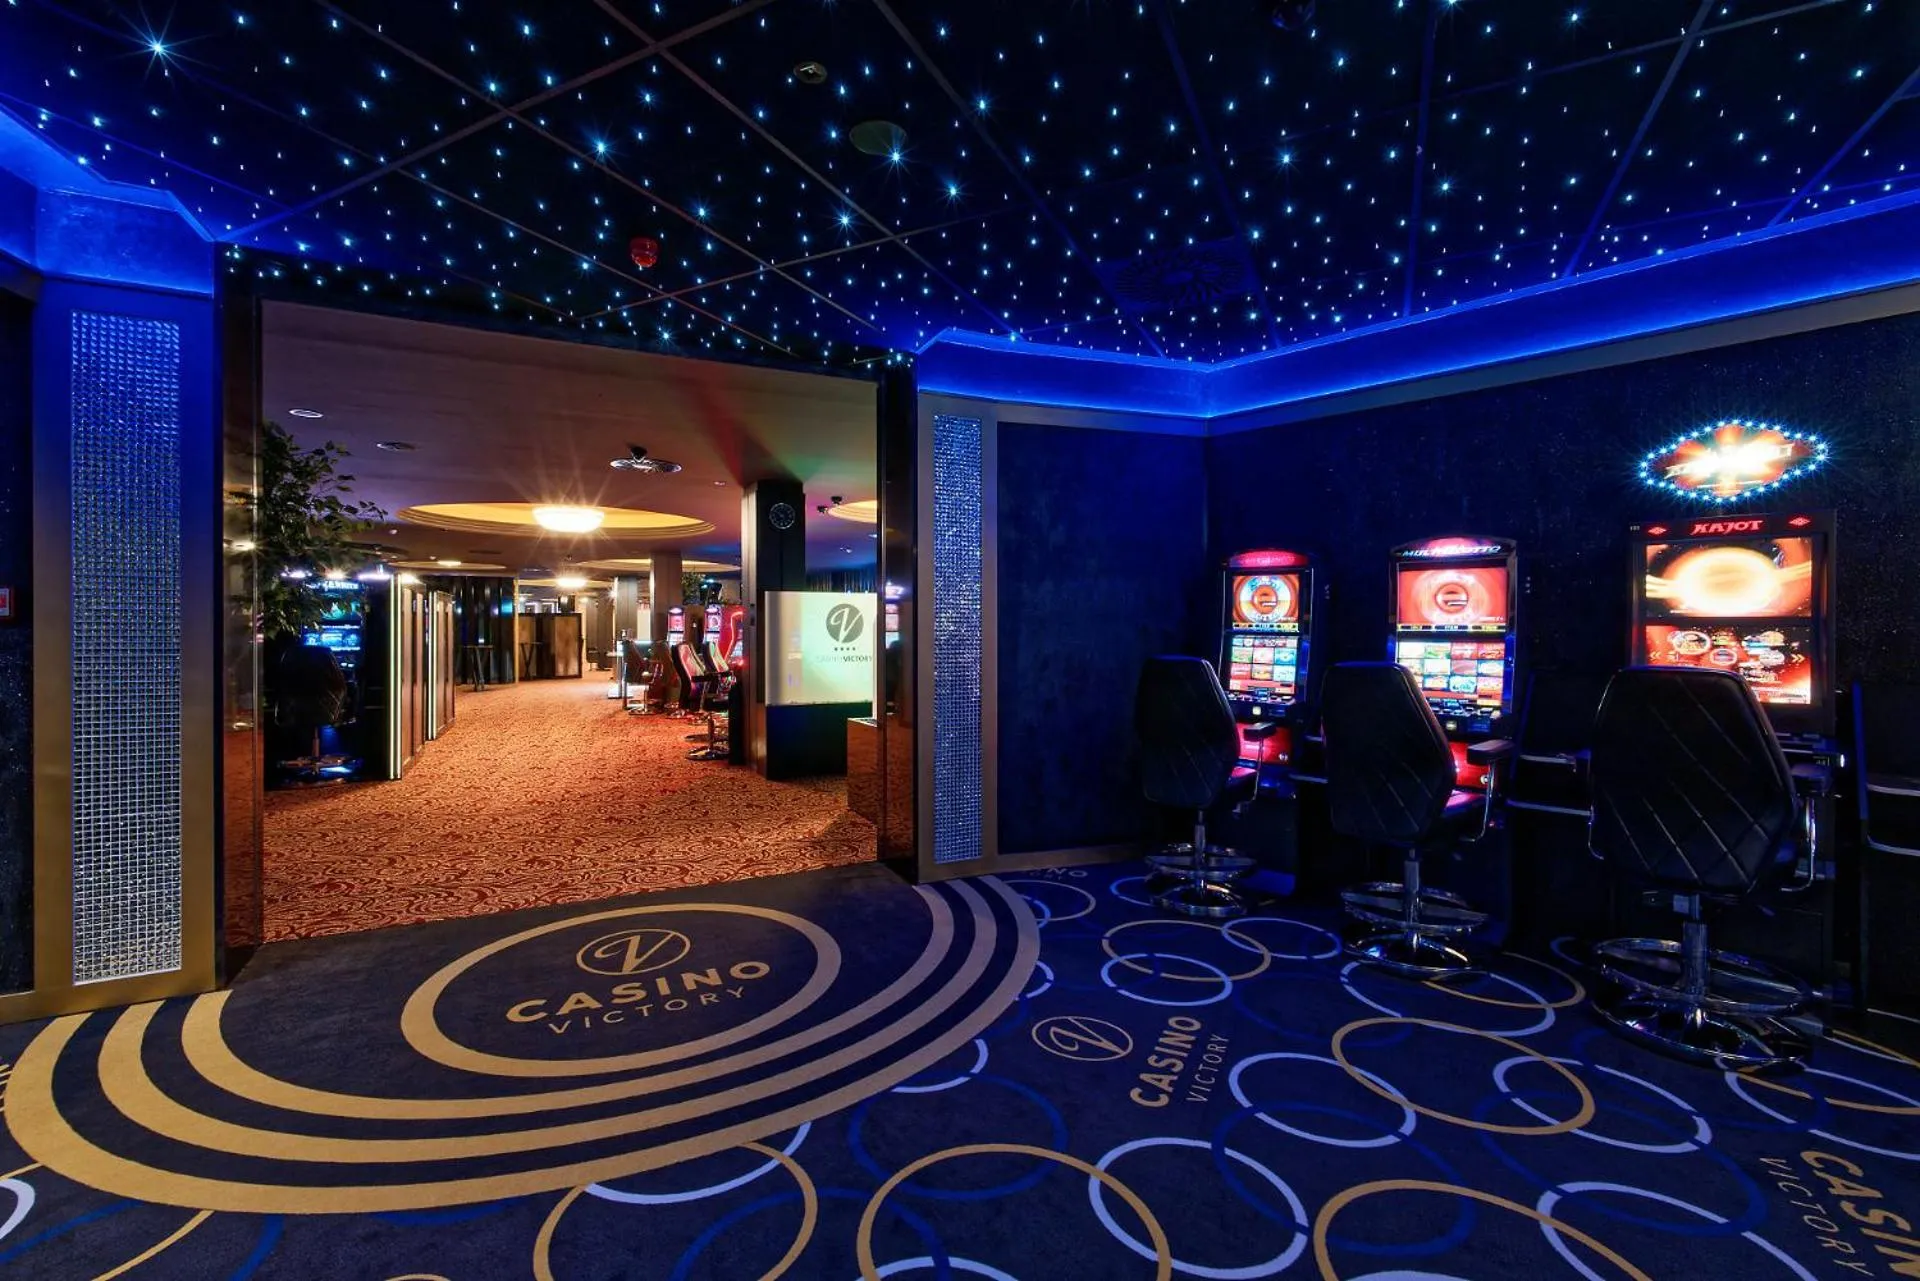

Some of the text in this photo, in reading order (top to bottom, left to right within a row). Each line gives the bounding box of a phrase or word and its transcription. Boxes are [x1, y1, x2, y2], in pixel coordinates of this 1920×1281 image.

[1690, 520, 1764, 536] KAJOT
[506, 961, 771, 1022] CASINO
[548, 986, 745, 1034] VICTORY
[1129, 1016, 1201, 1108] CASINO
[1185, 1034, 1230, 1102] VICTORY
[1759, 1158, 1875, 1276] VICTORY
